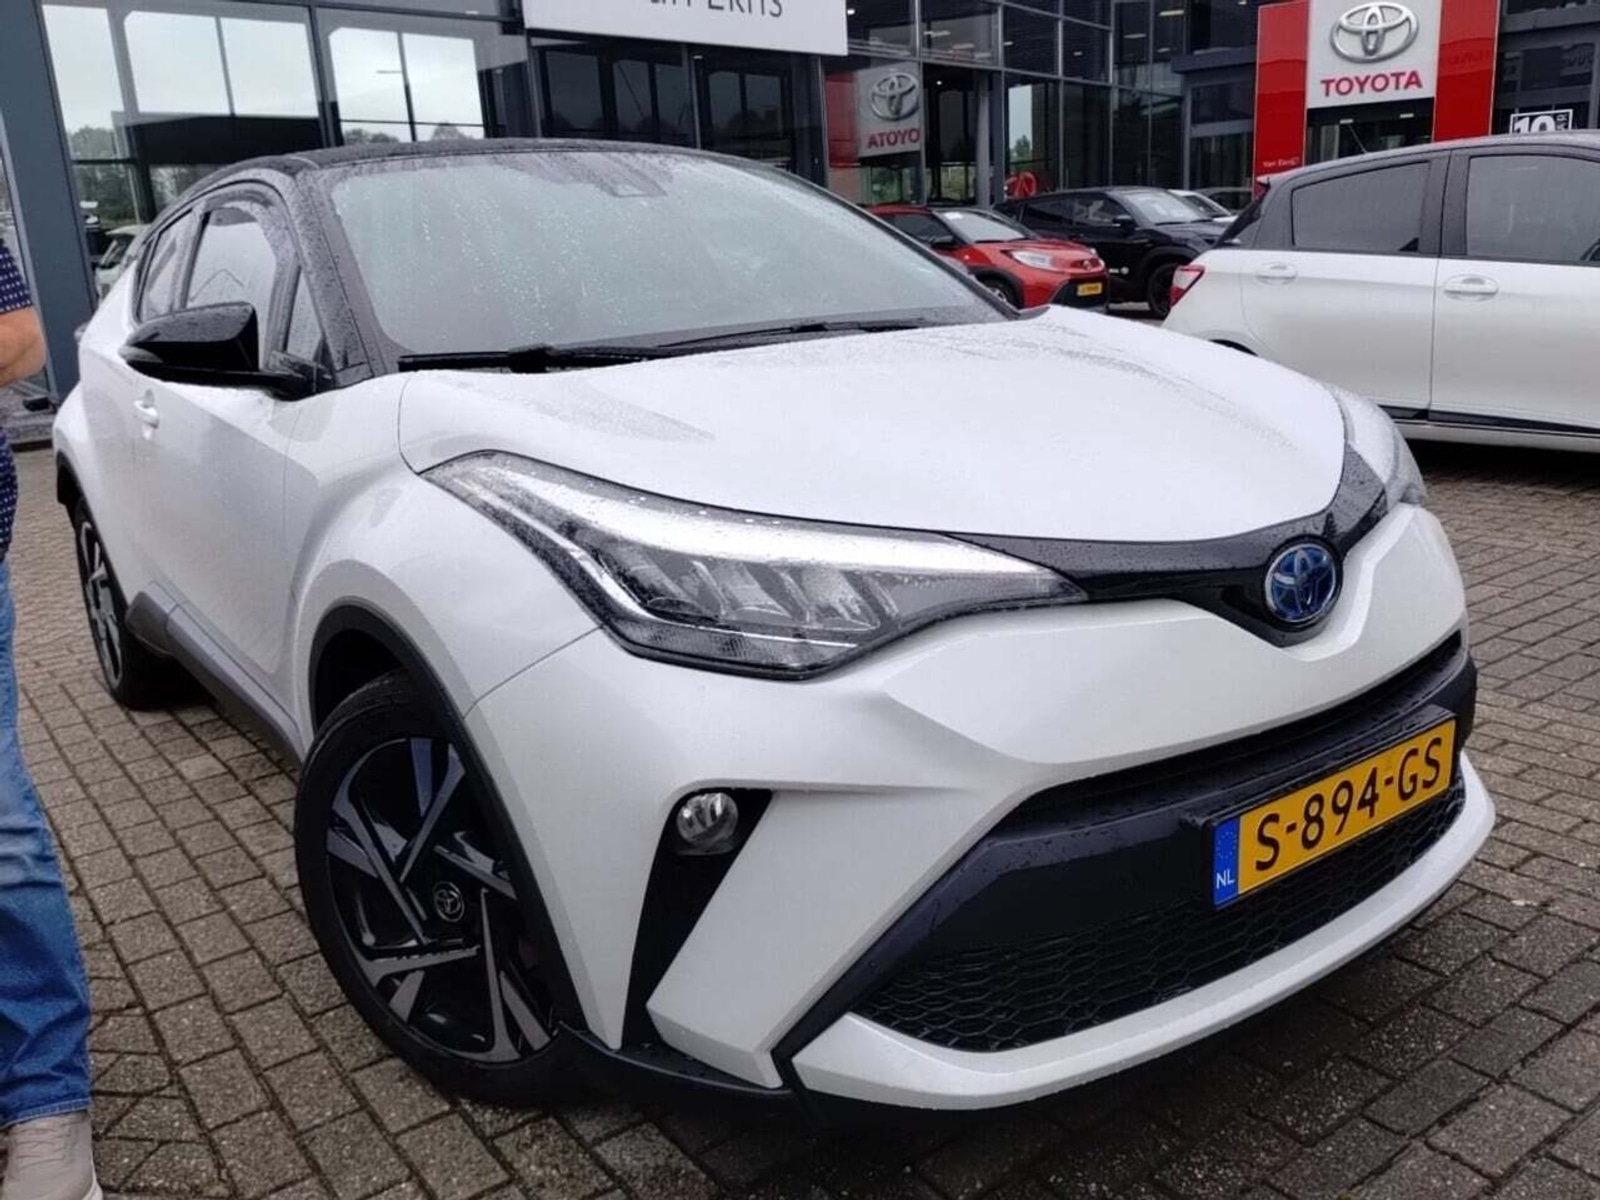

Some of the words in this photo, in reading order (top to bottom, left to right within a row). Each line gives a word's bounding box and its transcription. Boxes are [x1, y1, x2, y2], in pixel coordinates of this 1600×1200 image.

[1320, 70, 1422, 97] TOYOTA
[1255, 737, 1442, 871] S-894-GS
[1216, 868, 1235, 889] NL
